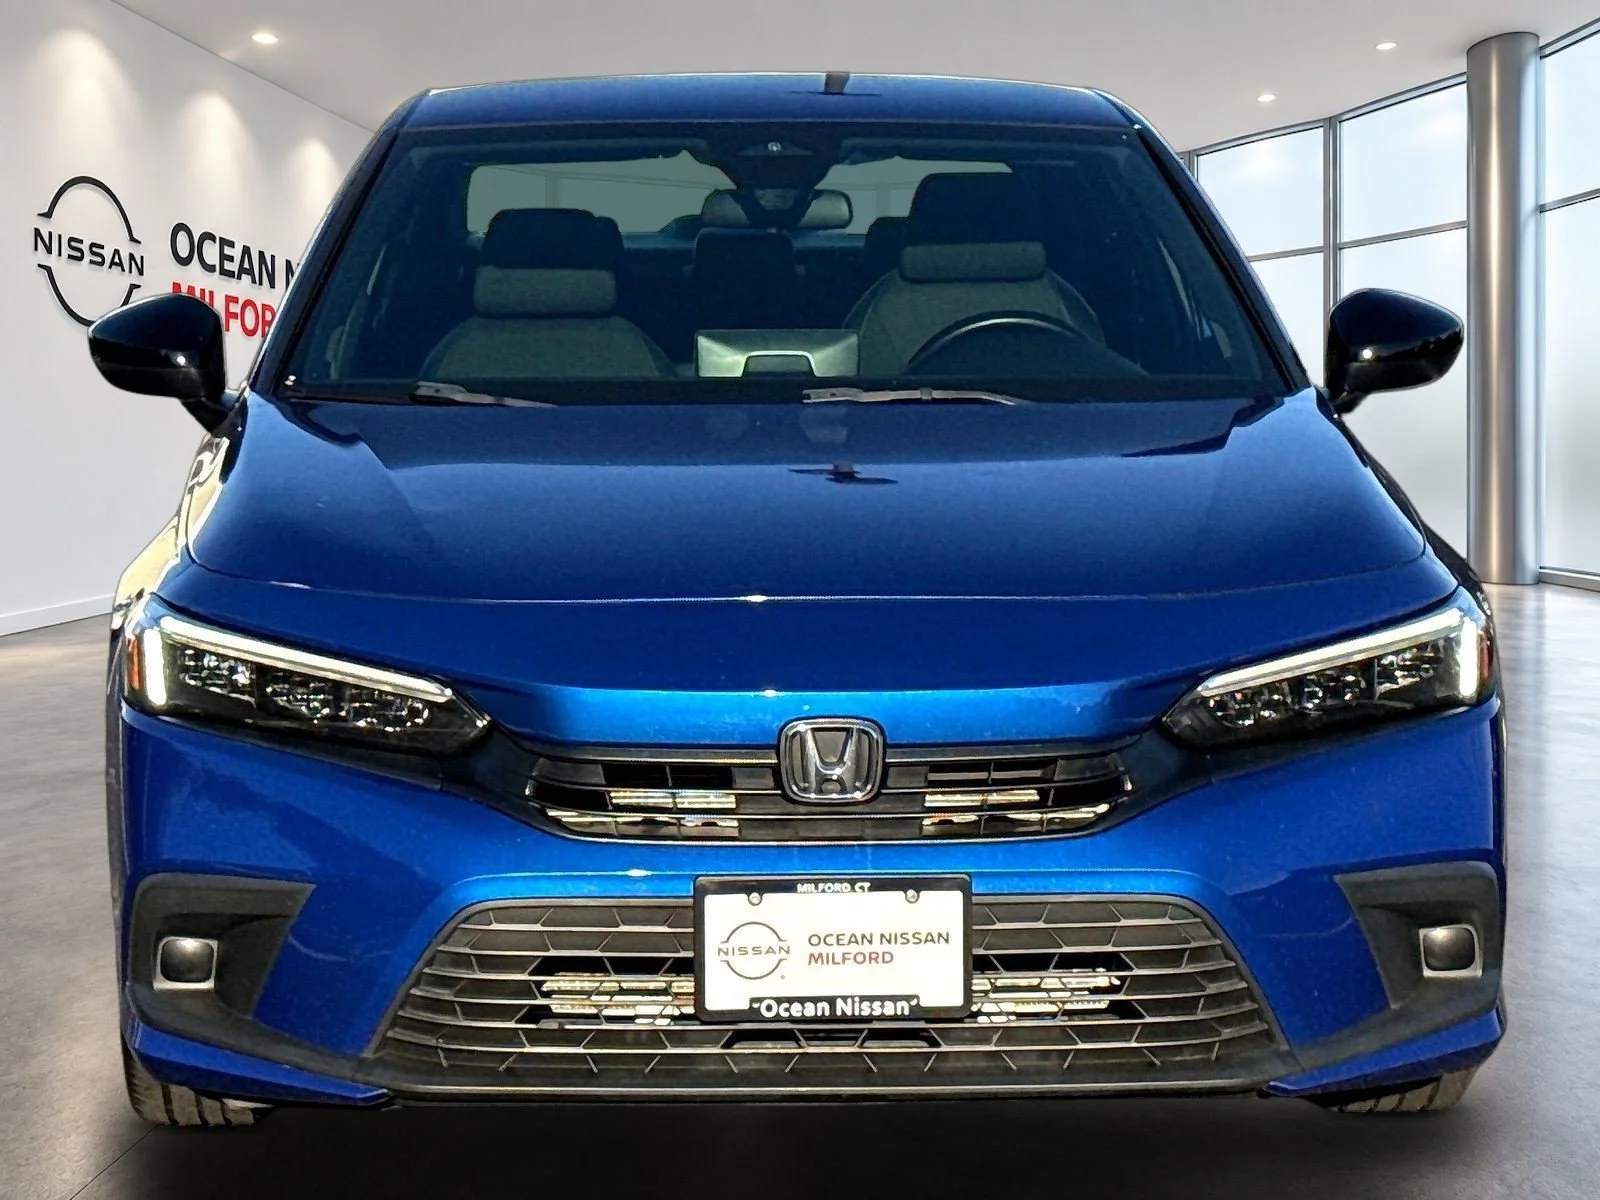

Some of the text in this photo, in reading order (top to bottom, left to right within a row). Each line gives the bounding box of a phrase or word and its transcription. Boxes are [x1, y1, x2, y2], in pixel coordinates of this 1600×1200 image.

[33, 228, 145, 277] NISSAN
[170, 222, 276, 289] OCEAN
[854, 881, 871, 893] CT
[807, 931, 950, 947] OCEAN NISSAN
[717, 945, 791, 958] NISSAN
[807, 951, 894, 966] MILFORD
[760, 996, 910, 1018] Ocean Nissan
